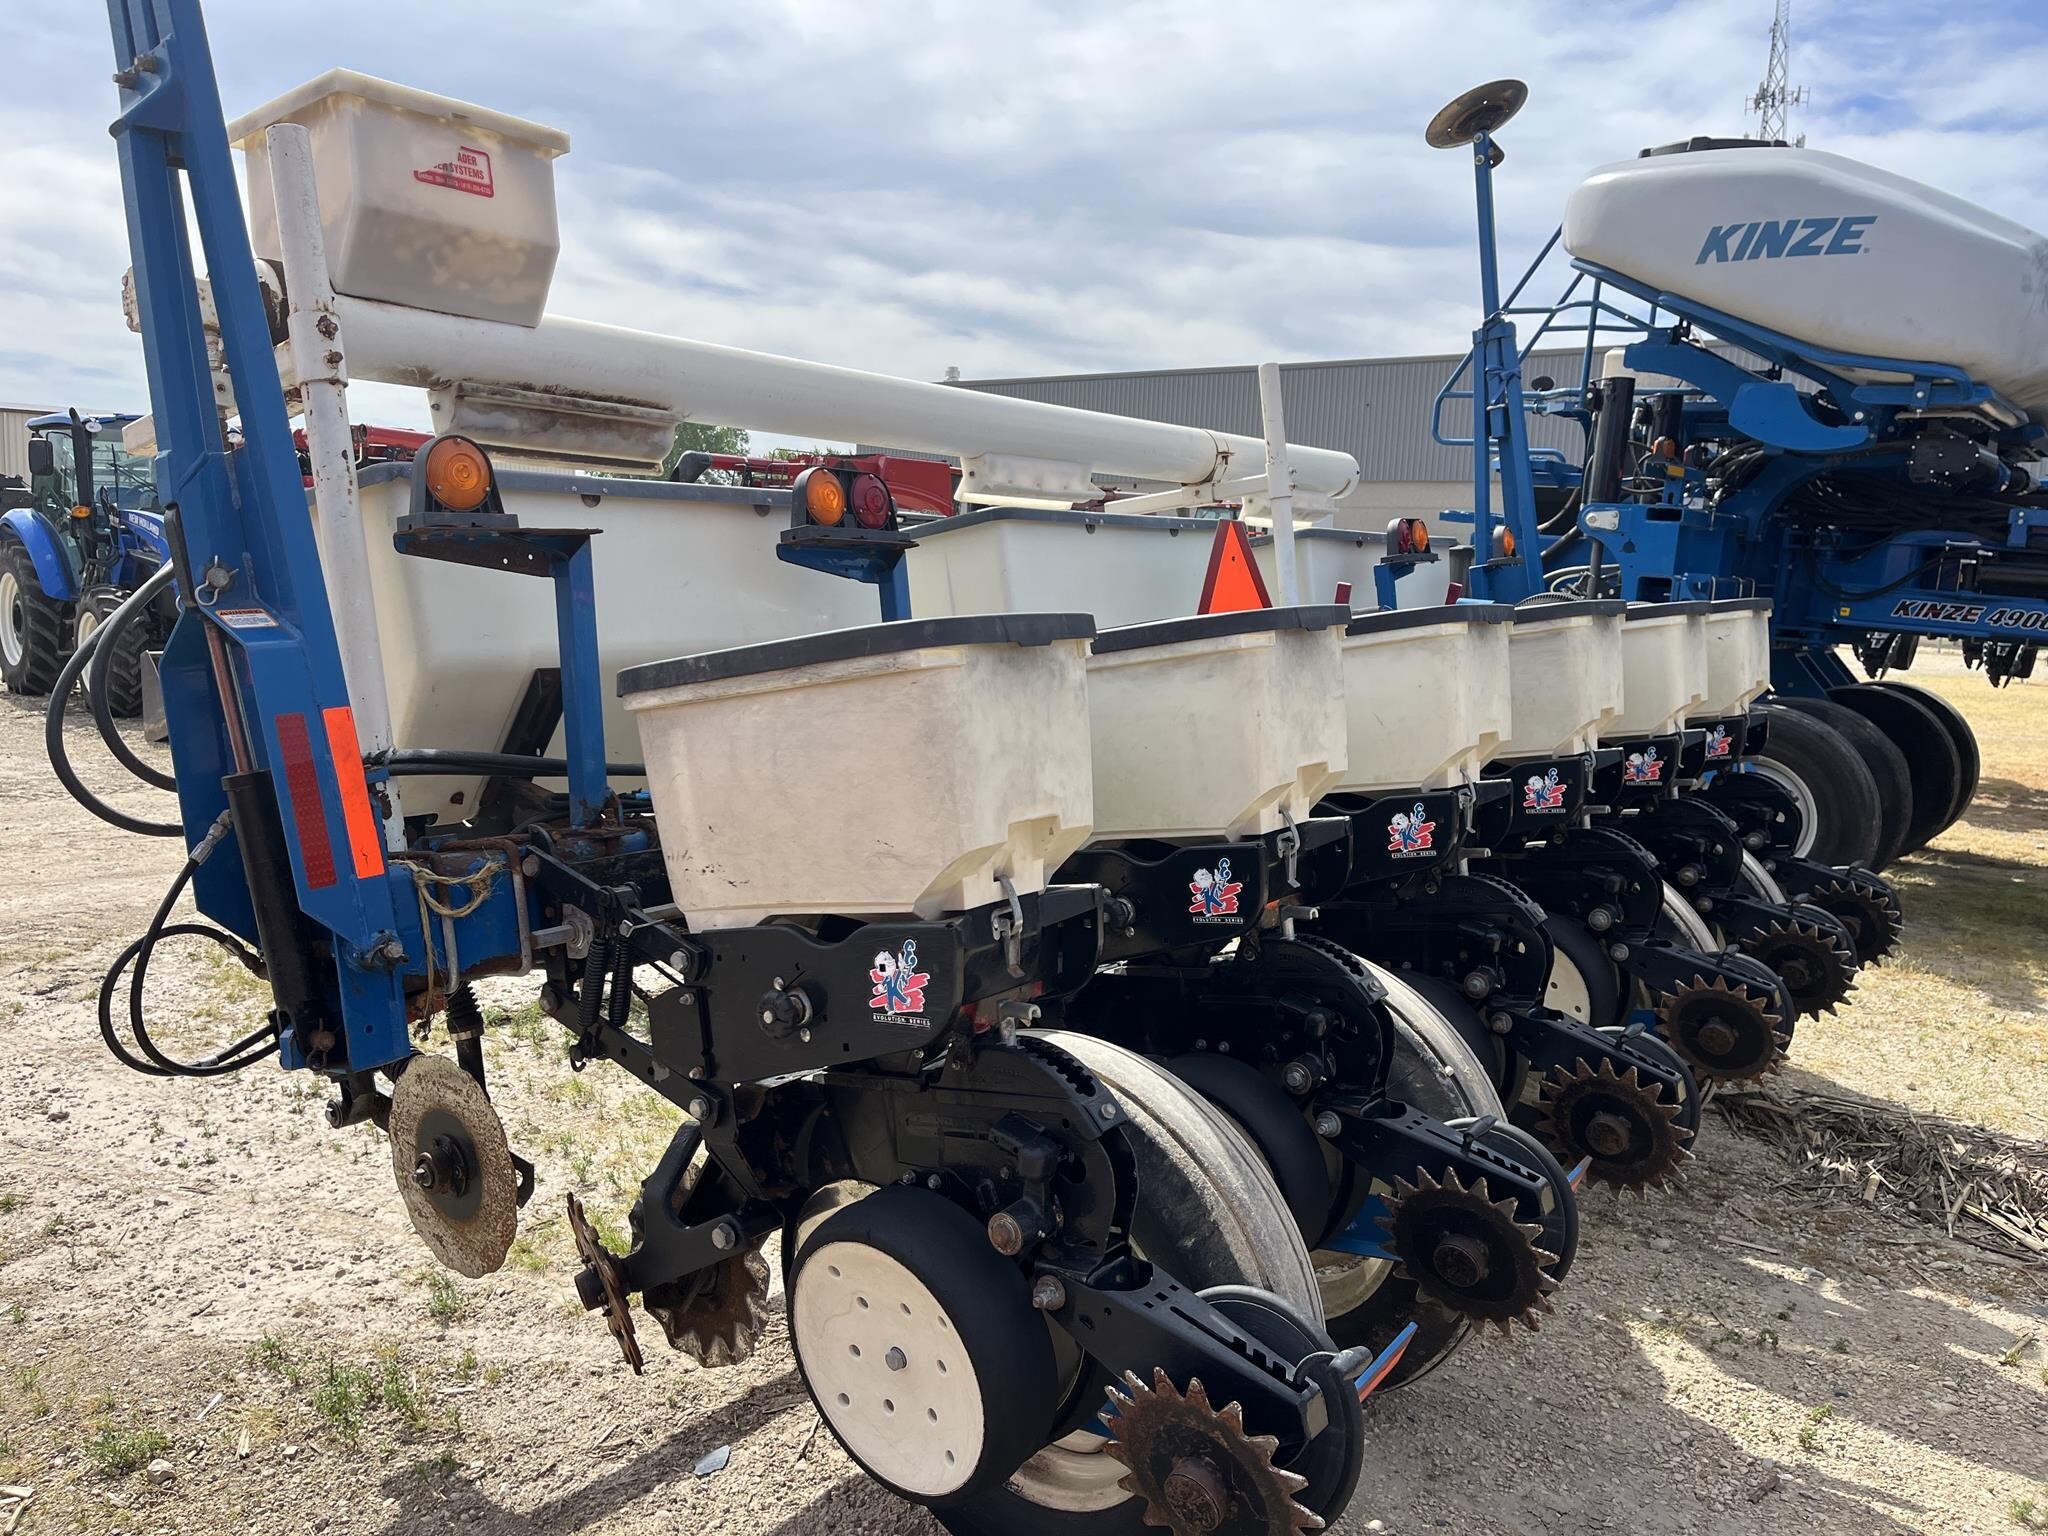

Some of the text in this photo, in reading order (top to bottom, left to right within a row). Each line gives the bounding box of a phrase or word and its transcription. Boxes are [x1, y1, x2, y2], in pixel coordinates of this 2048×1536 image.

[1695, 215, 1878, 265] KINZE
[128, 512, 160, 536] NEW HOLLAND
[1891, 599, 1987, 624] KINZE
[873, 1014, 930, 1026] EVOLUTION SERIES
